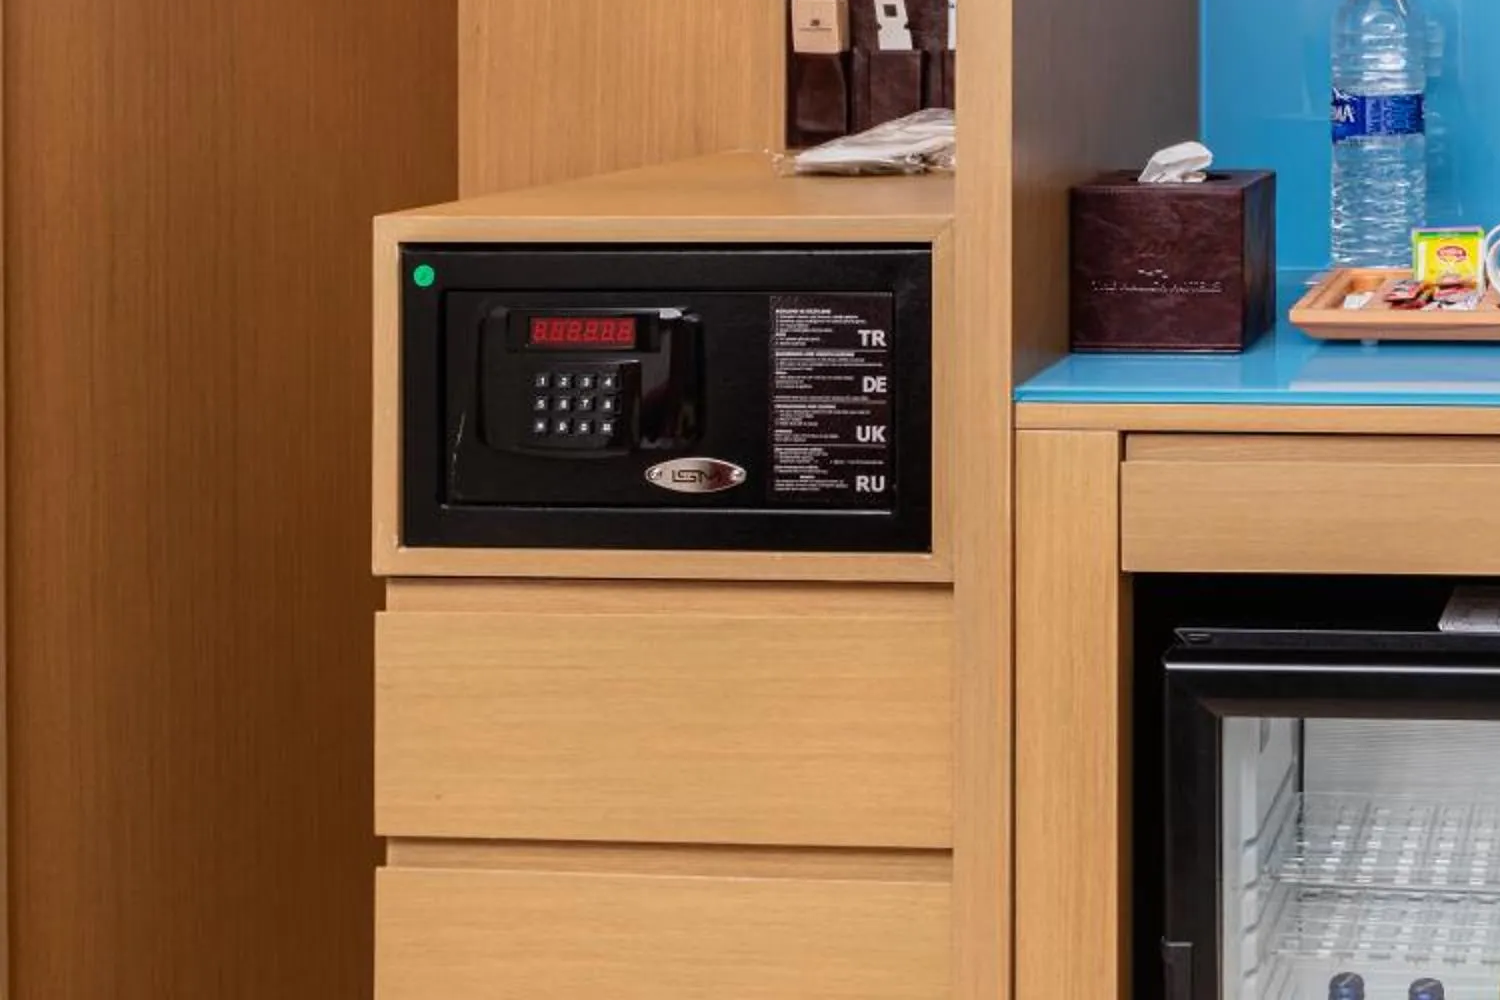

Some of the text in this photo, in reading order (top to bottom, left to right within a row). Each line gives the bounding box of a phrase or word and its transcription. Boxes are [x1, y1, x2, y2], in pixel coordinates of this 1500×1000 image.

[857, 329, 887, 347] TR
[862, 375, 887, 393] DE
[856, 425, 886, 443] UK
[855, 475, 885, 493] RU
